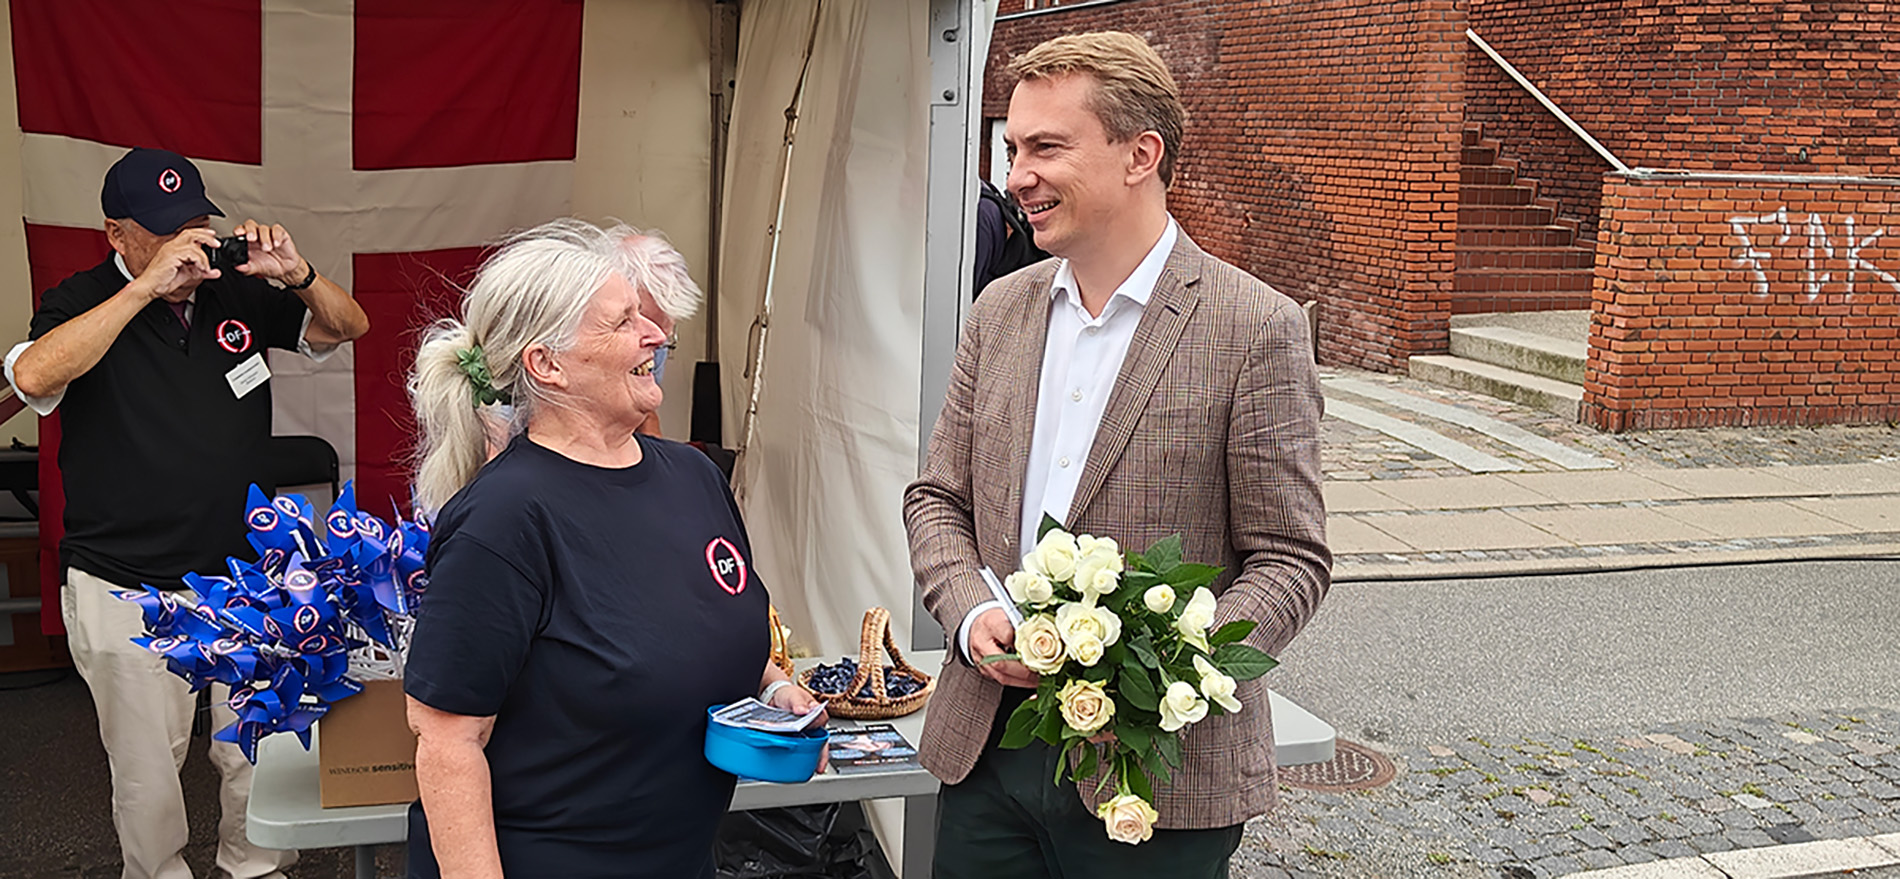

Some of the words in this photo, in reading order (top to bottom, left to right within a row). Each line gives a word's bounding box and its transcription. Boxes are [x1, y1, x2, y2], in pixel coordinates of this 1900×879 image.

[226, 329, 242, 343] DF
[717, 557, 735, 575] DF
[300, 613, 313, 625] DF
[328, 766, 370, 775] WINDSOR
